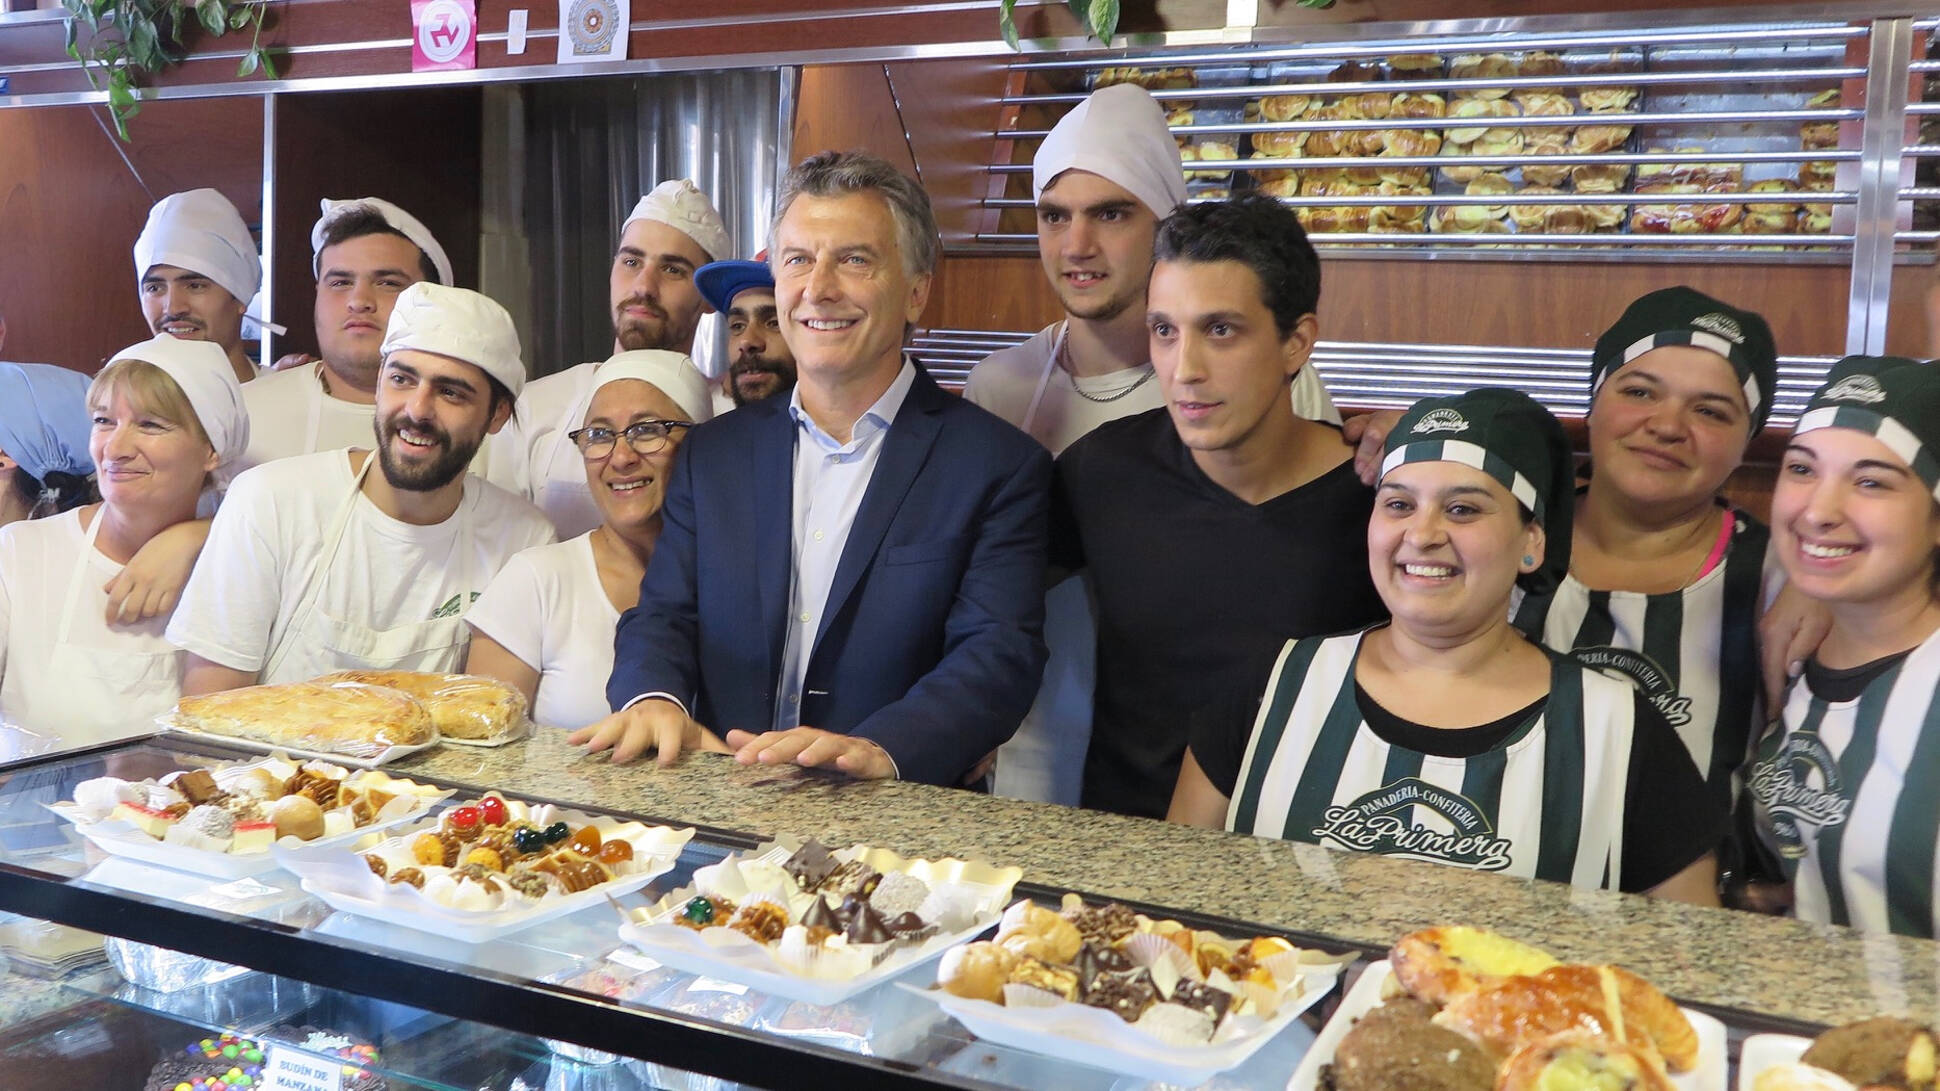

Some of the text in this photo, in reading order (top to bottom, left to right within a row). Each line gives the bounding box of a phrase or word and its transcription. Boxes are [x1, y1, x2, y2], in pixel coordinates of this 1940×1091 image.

[1360, 786, 1480, 831] PANADERIA-CONFITERIA
[1312, 807, 1512, 870] La Primera
